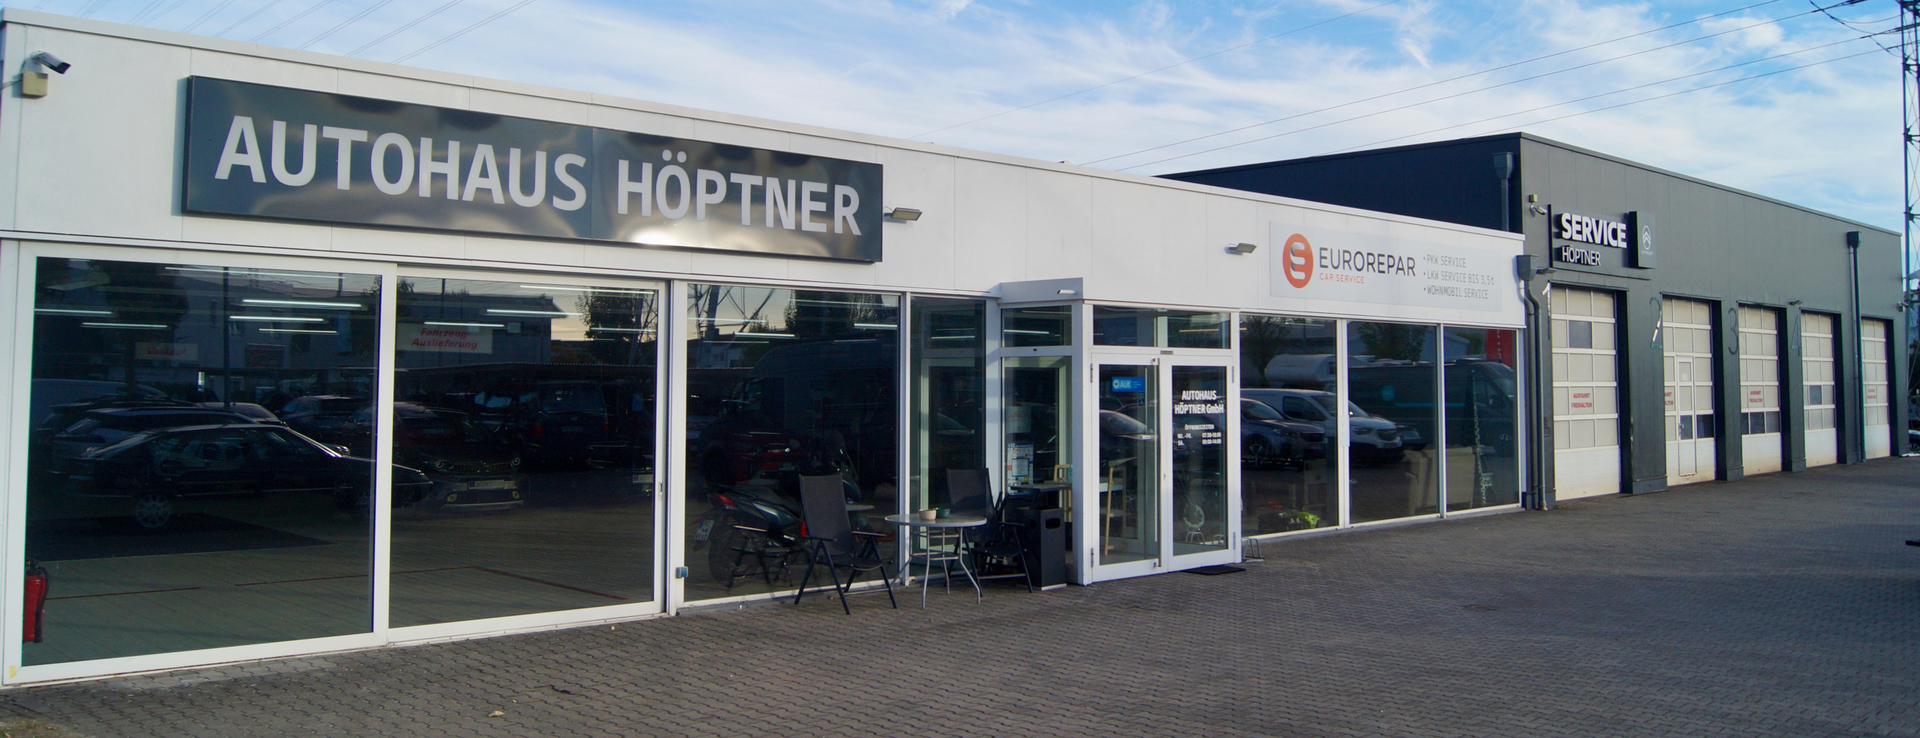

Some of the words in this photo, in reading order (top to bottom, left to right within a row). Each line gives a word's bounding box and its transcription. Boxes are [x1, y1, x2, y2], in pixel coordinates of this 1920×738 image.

[214, 115, 587, 211] AUTOHAUS
[617, 149, 862, 236] HÖPTNER
[1561, 212, 1627, 248] SERVICE
[1319, 246, 1416, 277] EUROREPAR
[1426, 253, 1438, 265] PKW
[1440, 255, 1466, 268] SERVICE
[1562, 244, 1601, 266] HÖPTNER
[1319, 272, 1333, 281] CAR
[1336, 273, 1364, 284] SERVICE
[1427, 269, 1439, 280] LKW
[1441, 270, 1467, 283] SERVICE
[1468, 273, 1479, 284] BIS
[1426, 284, 1462, 297] WOHNMOBIL
[1463, 287, 1489, 300] SERVICE
[421, 327, 470, 339] Fahrzeug-
[1728, 307, 1739, 356] 3
[411, 338, 478, 350] Auslieferung
[1181, 390, 1217, 400] AUTOHAUS
[1174, 402, 1206, 414] HÖPTNER
[1206, 403, 1224, 413] GmbH
